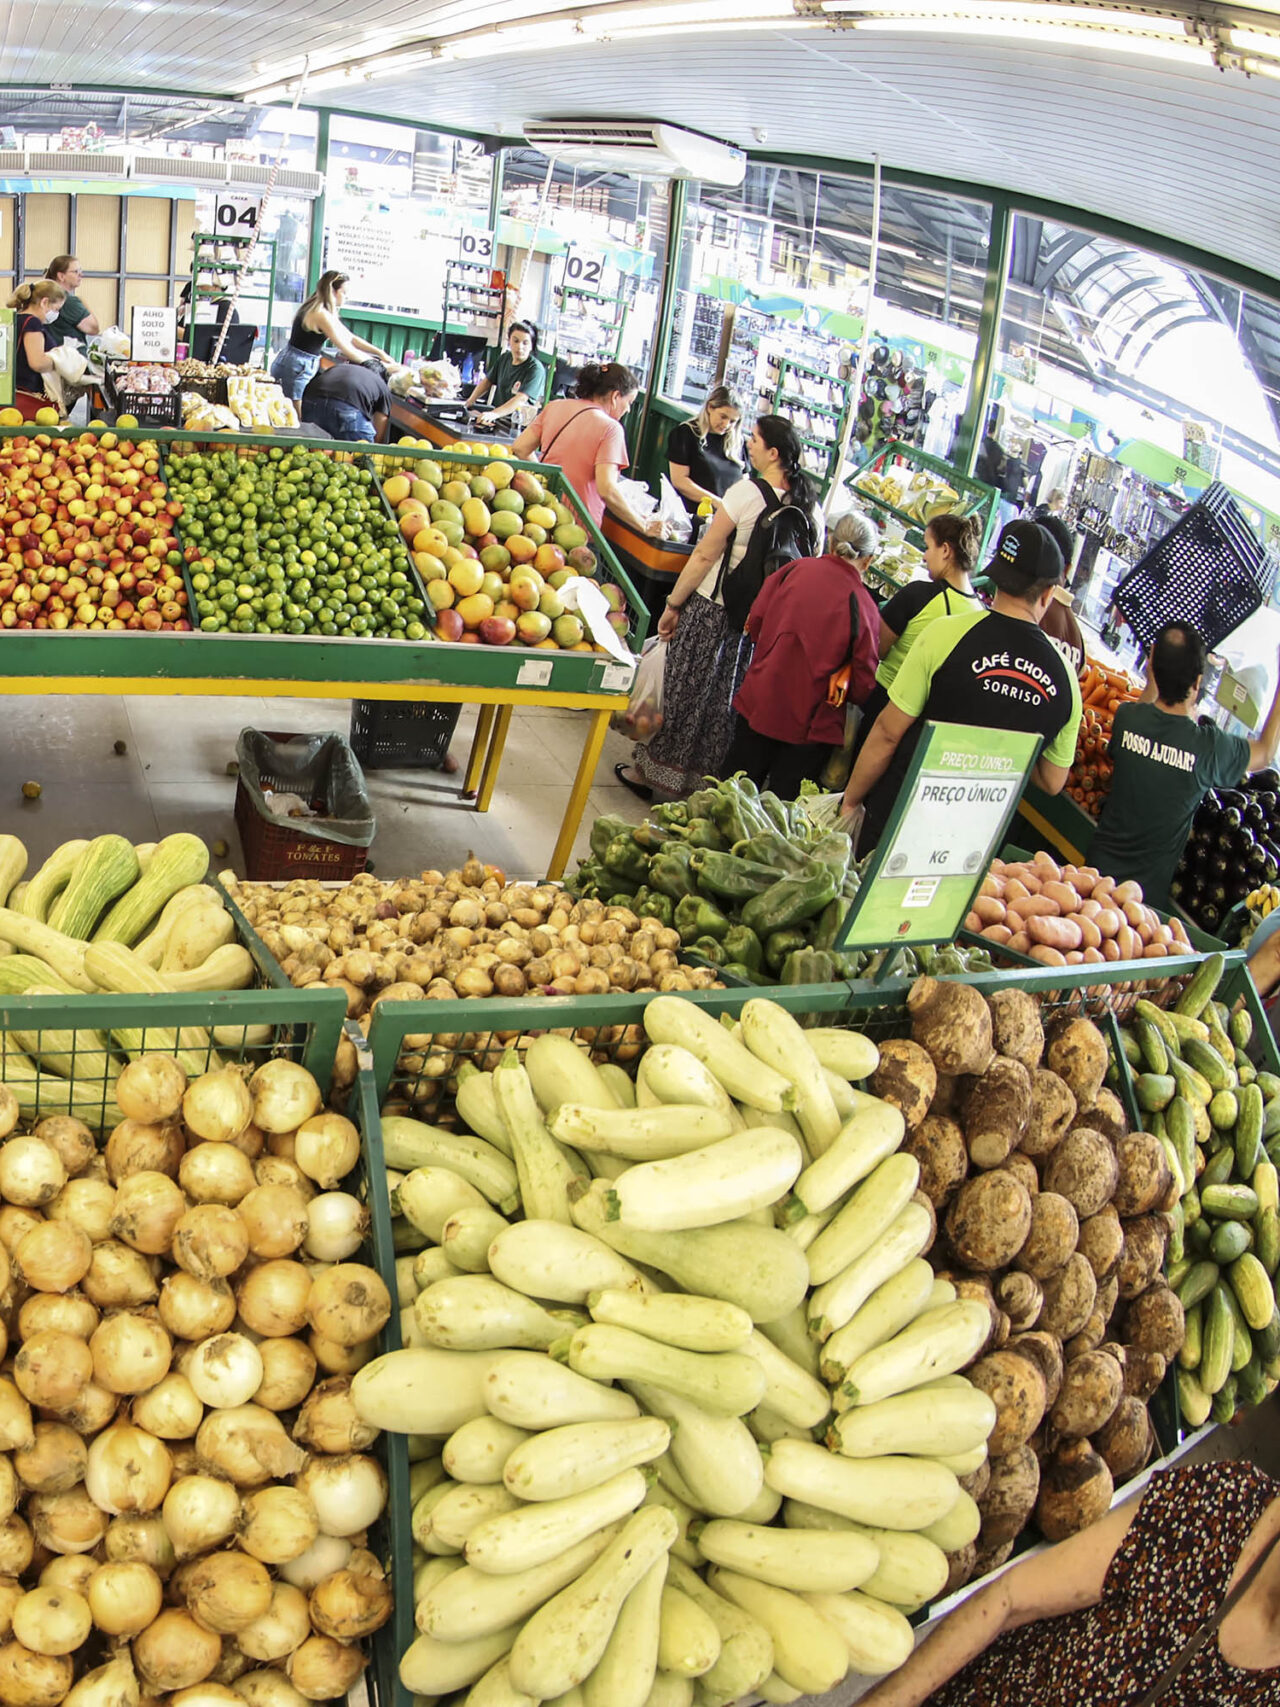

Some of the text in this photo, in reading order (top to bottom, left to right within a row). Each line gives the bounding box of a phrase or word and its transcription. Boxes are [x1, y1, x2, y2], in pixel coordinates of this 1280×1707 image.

[217, 203, 257, 229] 04
[462, 235, 491, 256] 03
[567, 257, 601, 283] 02
[141, 320, 165, 328] SOLTO
[142, 310, 164, 319] ALHO
[971, 652, 1057, 697] CAFÉ CHOPP
[983, 679, 1041, 706] SORRISO
[939, 752, 1013, 771] PREÇO ÚNICO
[1121, 730, 1196, 772] POSSO AJUDAR?
[921, 783, 1007, 805] PREÇO ÚNICO
[287, 851, 340, 862] TOMATES
[929, 851, 950, 864] KG
